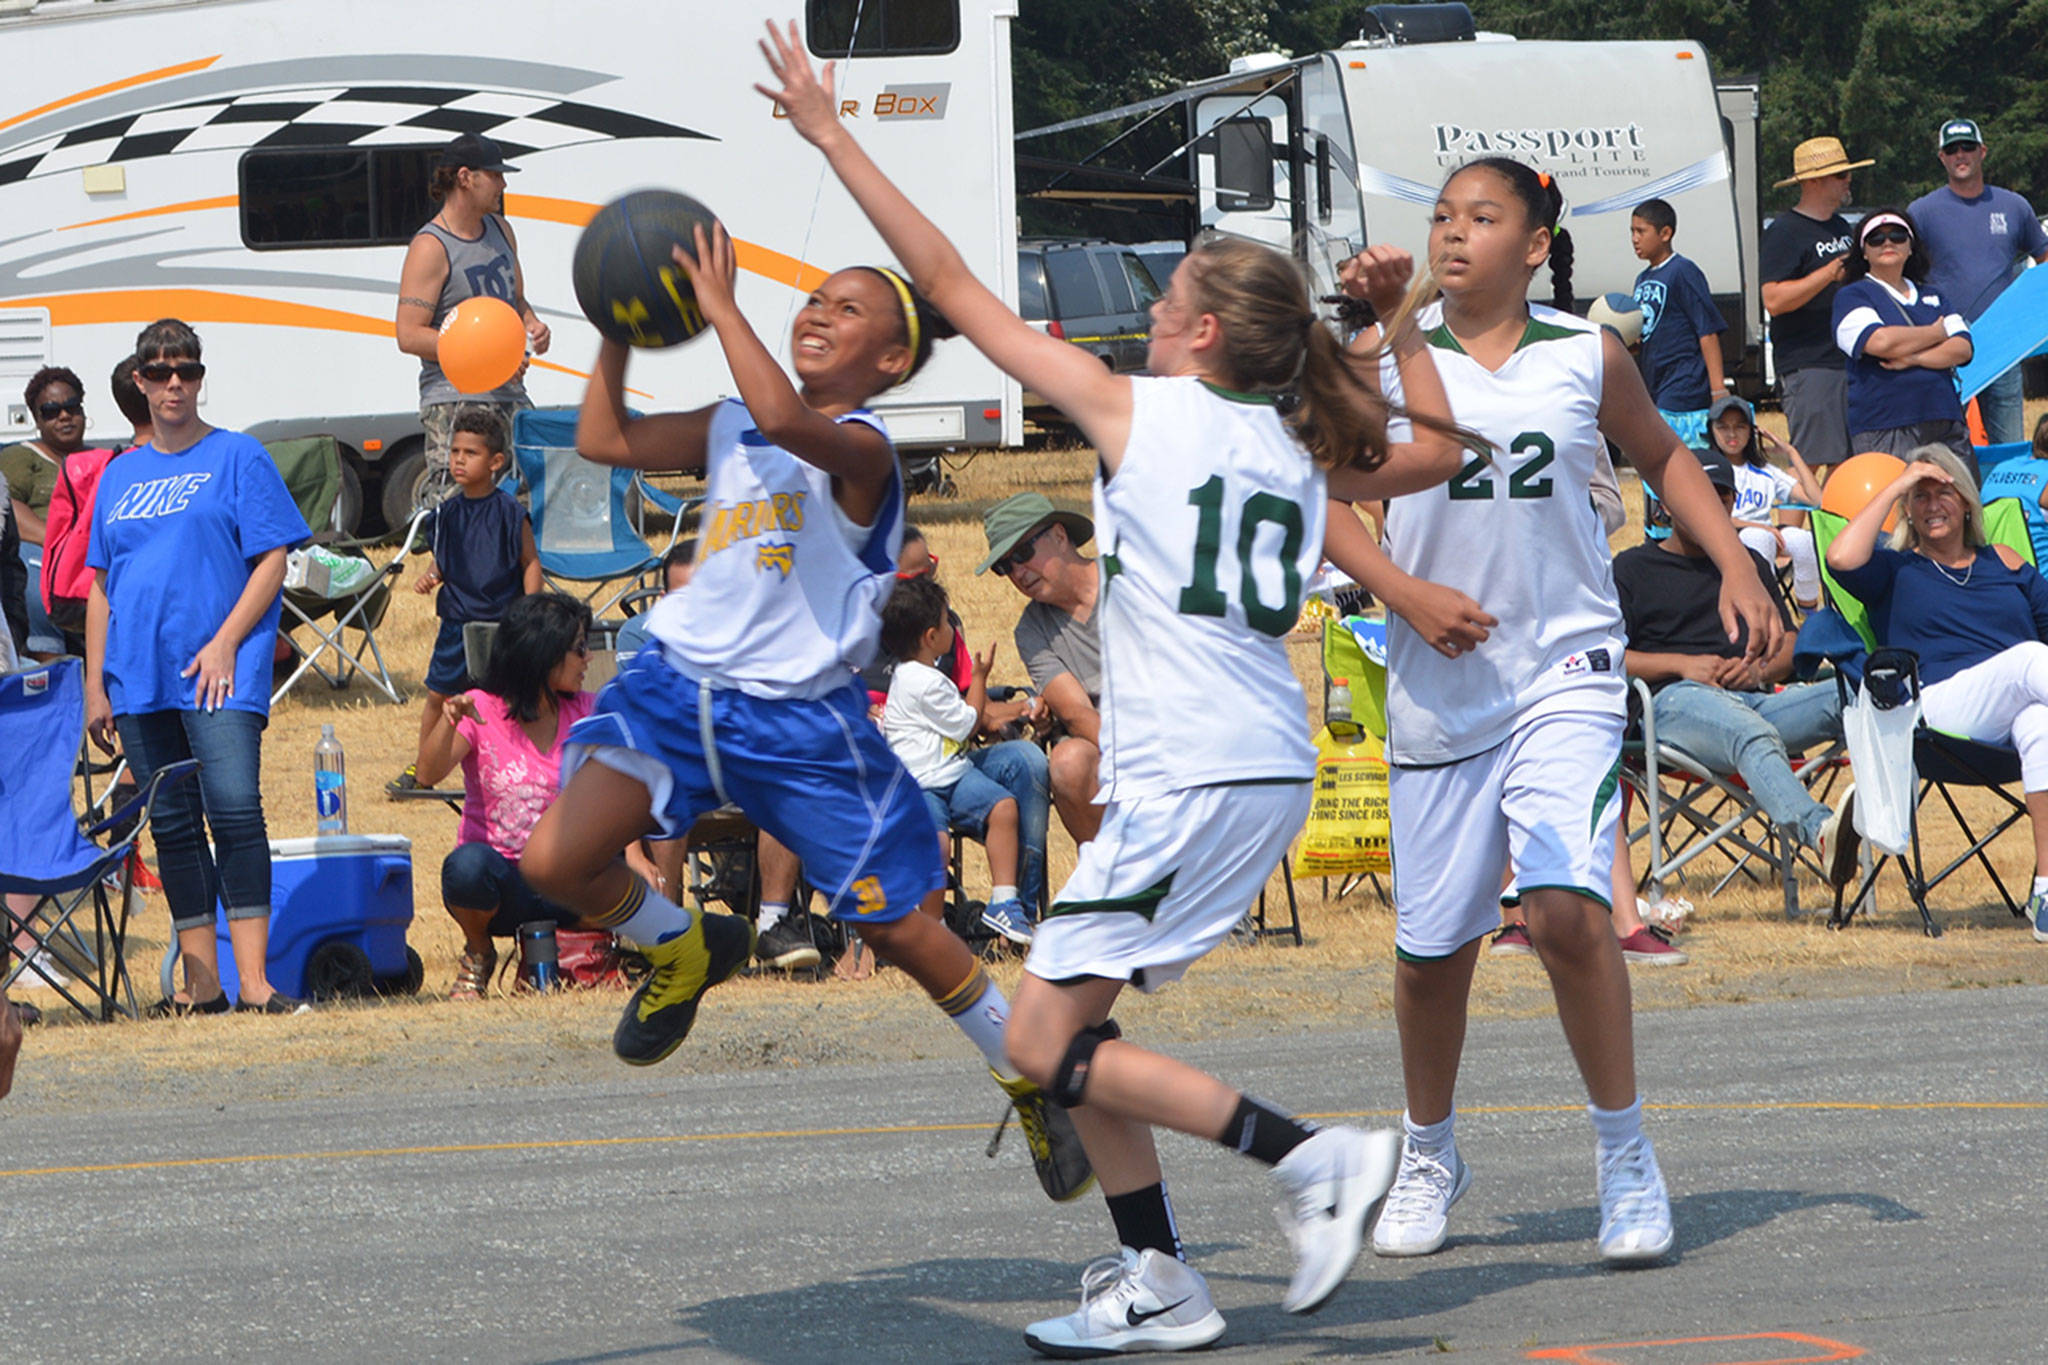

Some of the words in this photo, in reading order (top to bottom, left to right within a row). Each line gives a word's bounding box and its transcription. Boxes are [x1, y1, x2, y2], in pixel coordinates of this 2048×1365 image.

[873, 93, 939, 115] Box
[1434, 120, 1646, 158] Passport
[1571, 149, 1647, 164] LITE
[1590, 165, 1651, 178] Touring
[1448, 431, 1555, 500] 22
[106, 472, 213, 525] NIKE
[1178, 474, 1304, 638] 10
[1363, 797, 1389, 808] RIGH
[1338, 809, 1369, 820] SINCE
